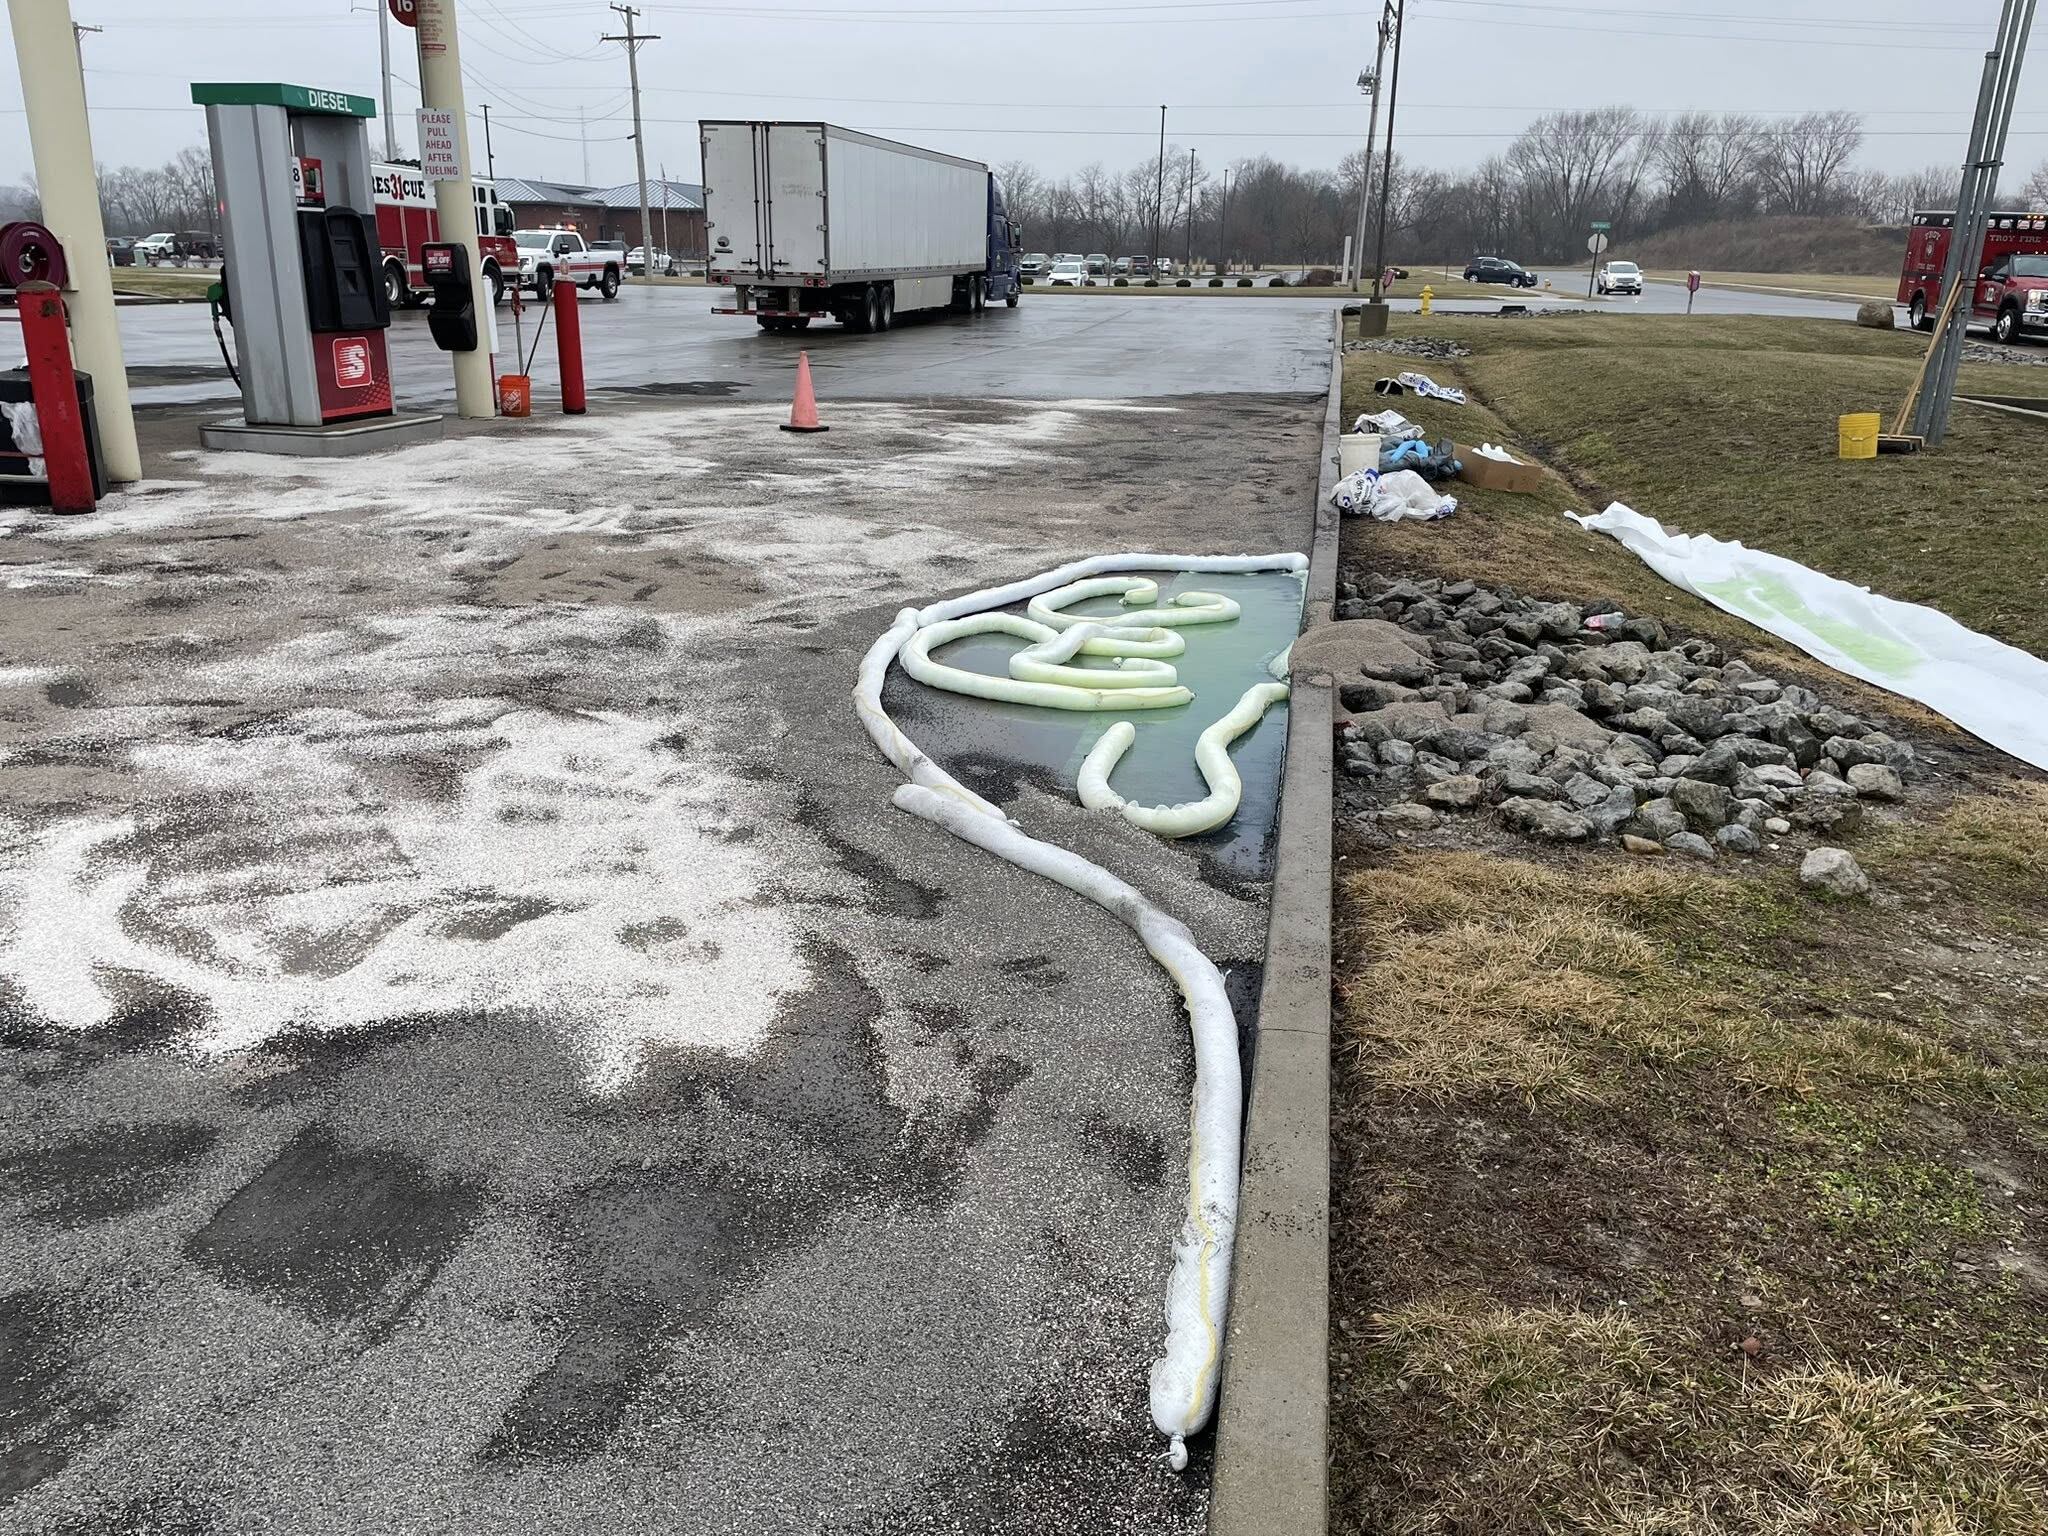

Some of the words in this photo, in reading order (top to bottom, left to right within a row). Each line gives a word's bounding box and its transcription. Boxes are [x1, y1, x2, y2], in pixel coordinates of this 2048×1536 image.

[308, 90, 353, 113] DIESEL
[421, 114, 451, 124] PLEASE
[427, 127, 448, 137] PULL
[425, 140, 452, 150] AHEAD
[427, 153, 453, 163] AFTER
[424, 165, 458, 176] FUELING
[1925, 230, 1941, 241] TROY
[1989, 234, 2016, 242] TROY
